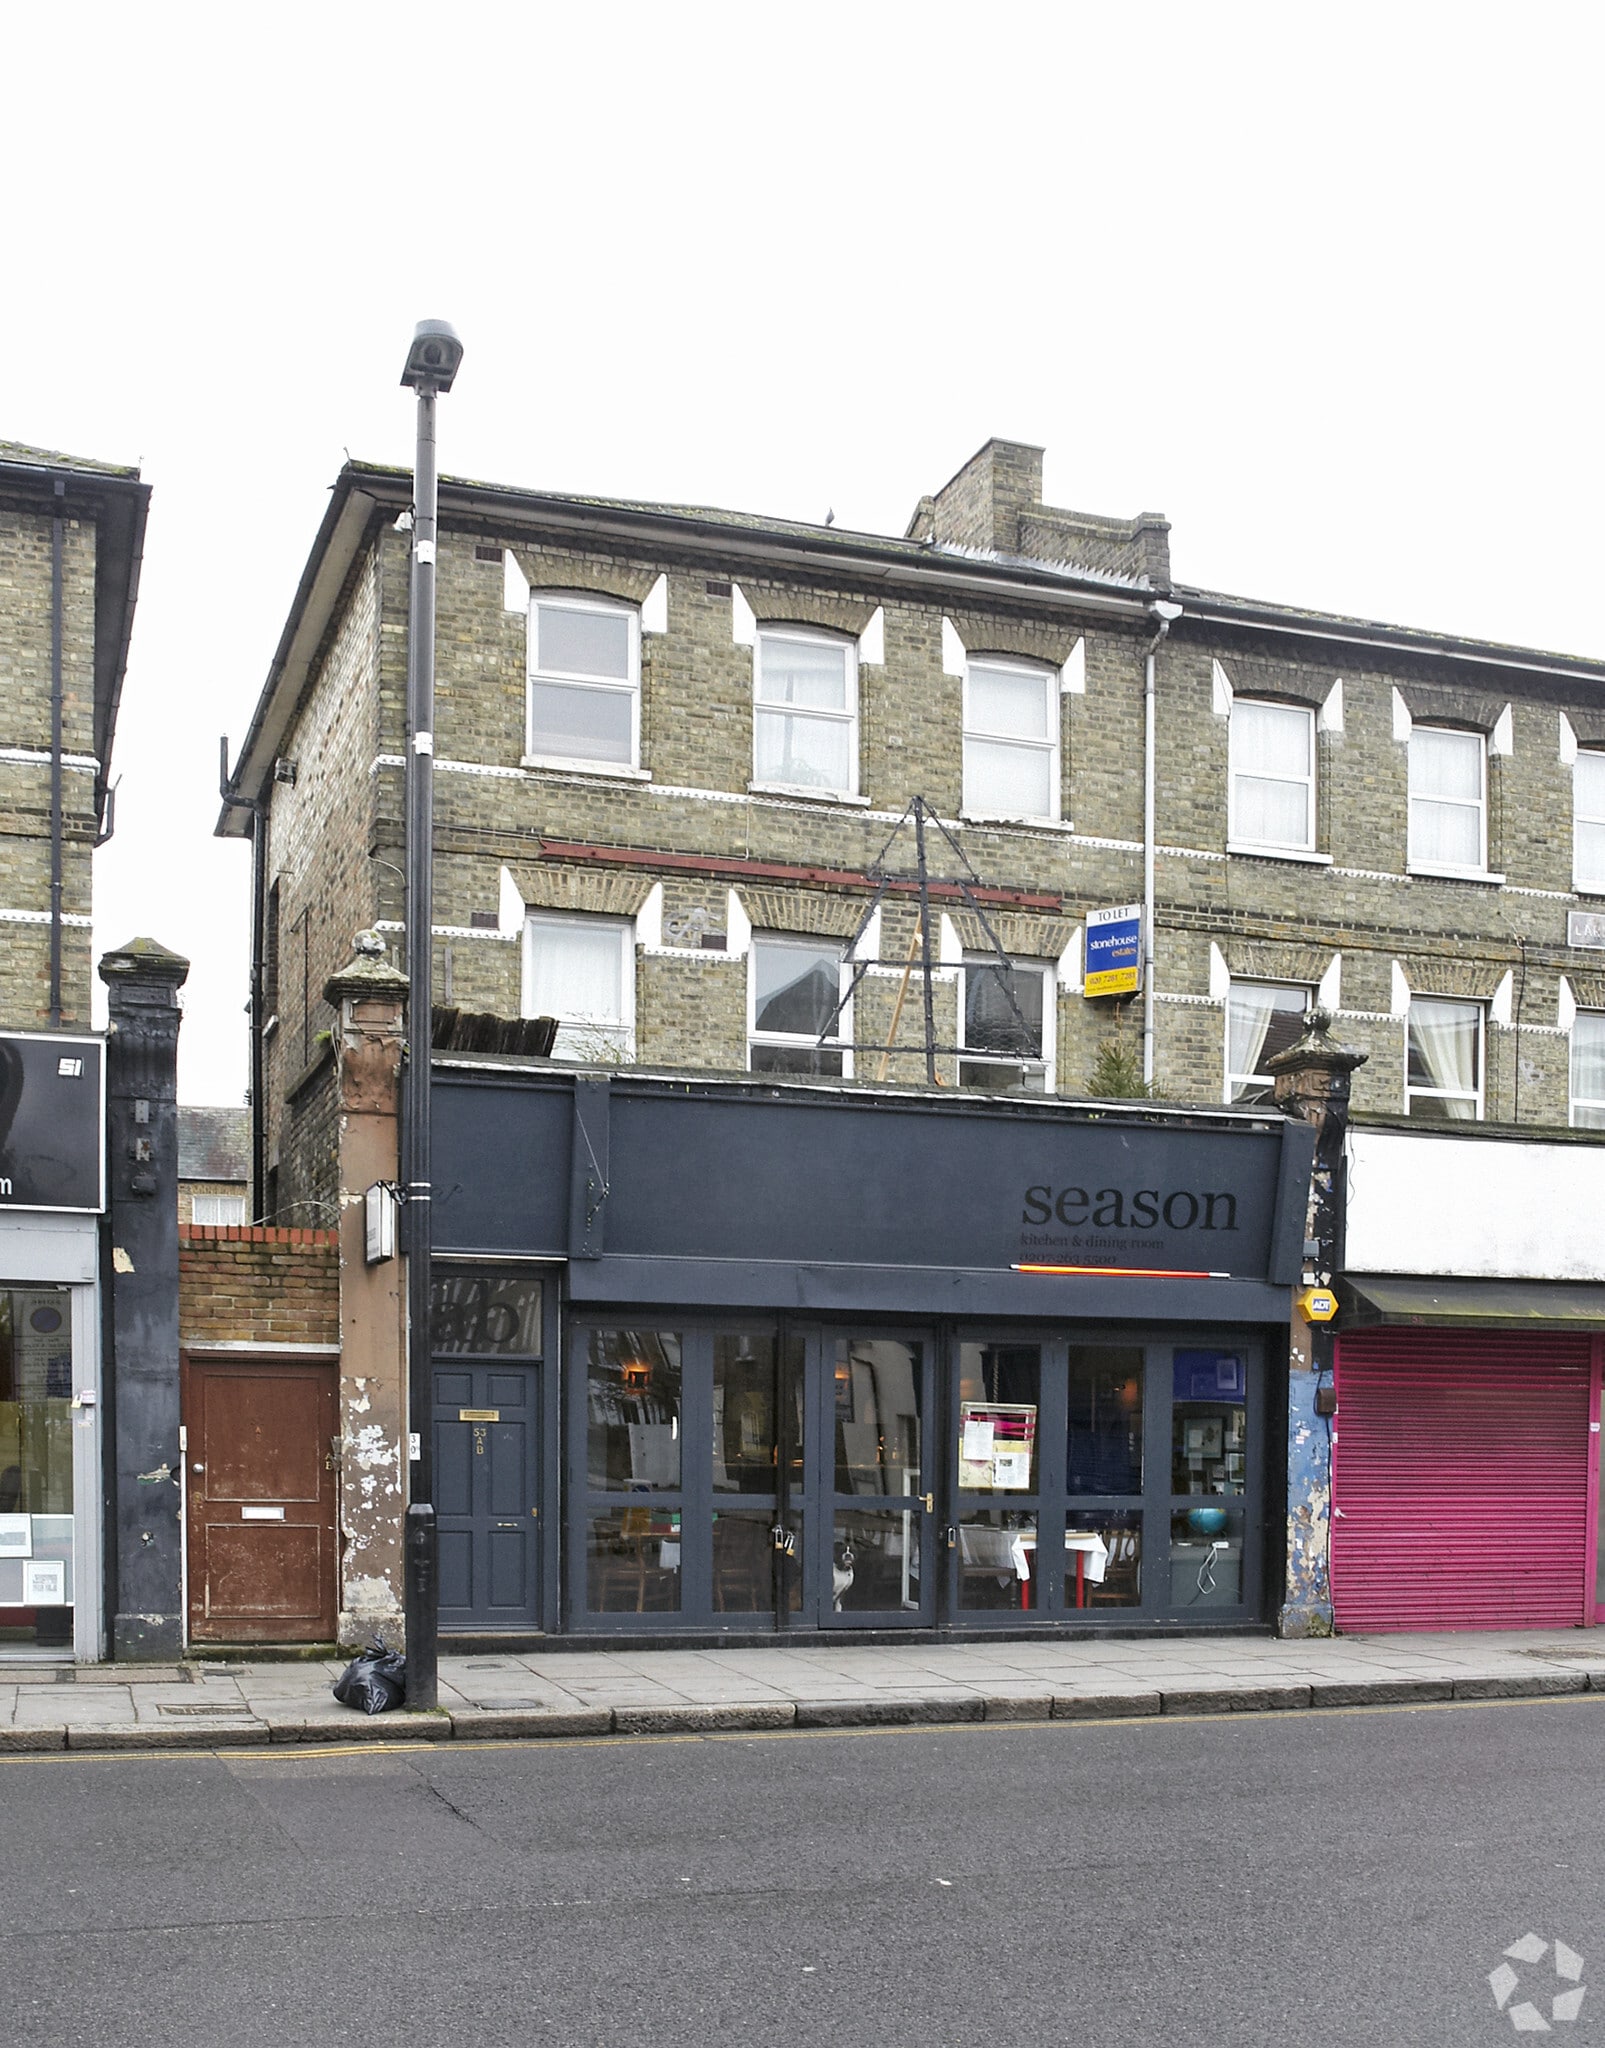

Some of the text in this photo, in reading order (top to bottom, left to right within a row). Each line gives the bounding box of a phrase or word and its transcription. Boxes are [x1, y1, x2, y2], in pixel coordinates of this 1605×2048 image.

[1098, 907, 1130, 921] TO LET
[1090, 935, 1138, 950] stonehouse
[1022, 1185, 1240, 1231] season
[1020, 1232, 1164, 1250] kitchen & dining room
[1313, 1300, 1330, 1311] ADT
[473, 1428, 487, 1437] 53
[476, 1445, 484, 1455] B
